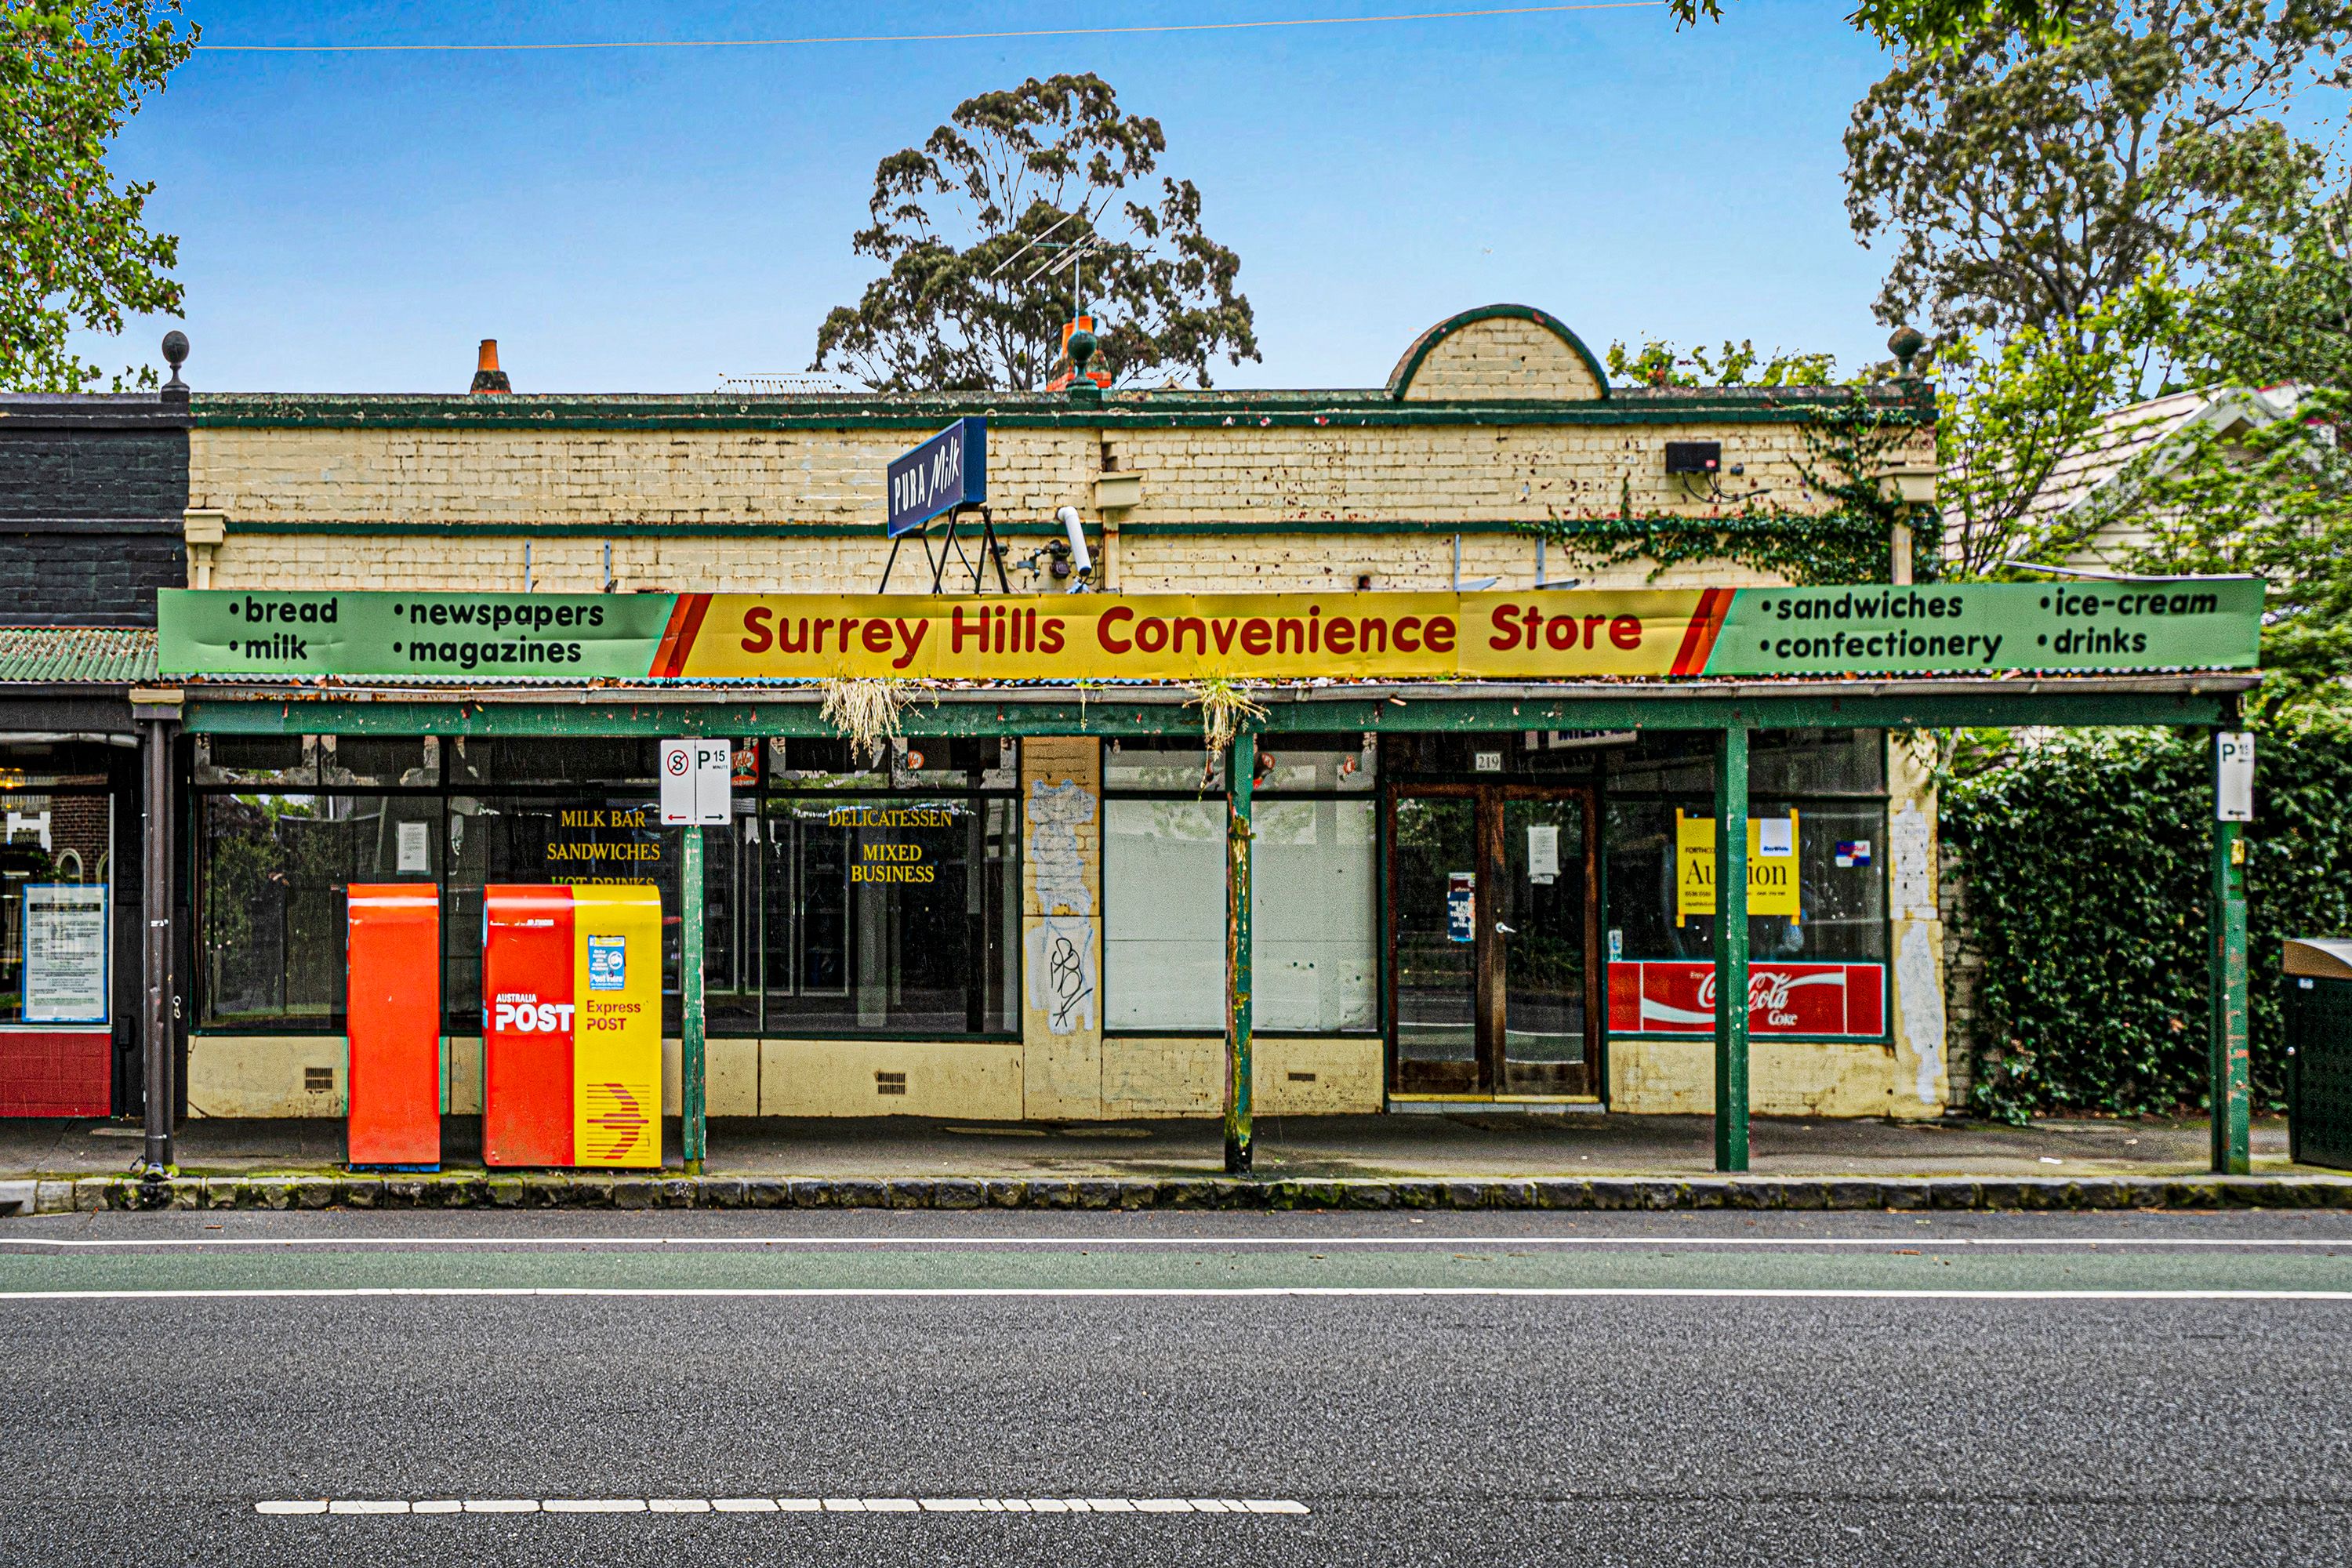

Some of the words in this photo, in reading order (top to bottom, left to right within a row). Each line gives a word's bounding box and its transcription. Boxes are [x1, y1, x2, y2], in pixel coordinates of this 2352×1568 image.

[894, 463, 925, 516] PURA
[927, 436, 960, 508] Milk
[245, 596, 338, 624] bread
[1776, 591, 1963, 620] sandwiches
[2056, 587, 2217, 616] ice-cream
[410, 603, 604, 630] newspapers
[245, 633, 307, 660] milk
[740, 606, 929, 669] Surrey
[951, 604, 1065, 654] Hills
[1097, 604, 1457, 655] Convenience
[1489, 604, 1642, 651] Store
[1775, 629, 2003, 664] confectionery
[2053, 627, 2147, 654] drinks
[409, 634, 582, 670] magazines
[698, 750, 710, 769] P
[713, 750, 725, 762] 15
[1477, 755, 1500, 770] 219
[2223, 743, 2235, 761] P
[561, 810, 606, 827] MILK
[611, 810, 646, 828] BAR
[828, 809, 953, 827] DELICATESSEN
[546, 843, 661, 861] SANDWICHES
[863, 844, 923, 862] MIXED
[851, 865, 935, 883] BUSINESS
[1685, 858, 1788, 885] Auion
[495, 993, 537, 1003] AUSTRALIA
[586, 1000, 641, 1016] Express
[495, 1004, 575, 1032] POST
[586, 1018, 627, 1031] POST
[1769, 1009, 1798, 1026] Coke
